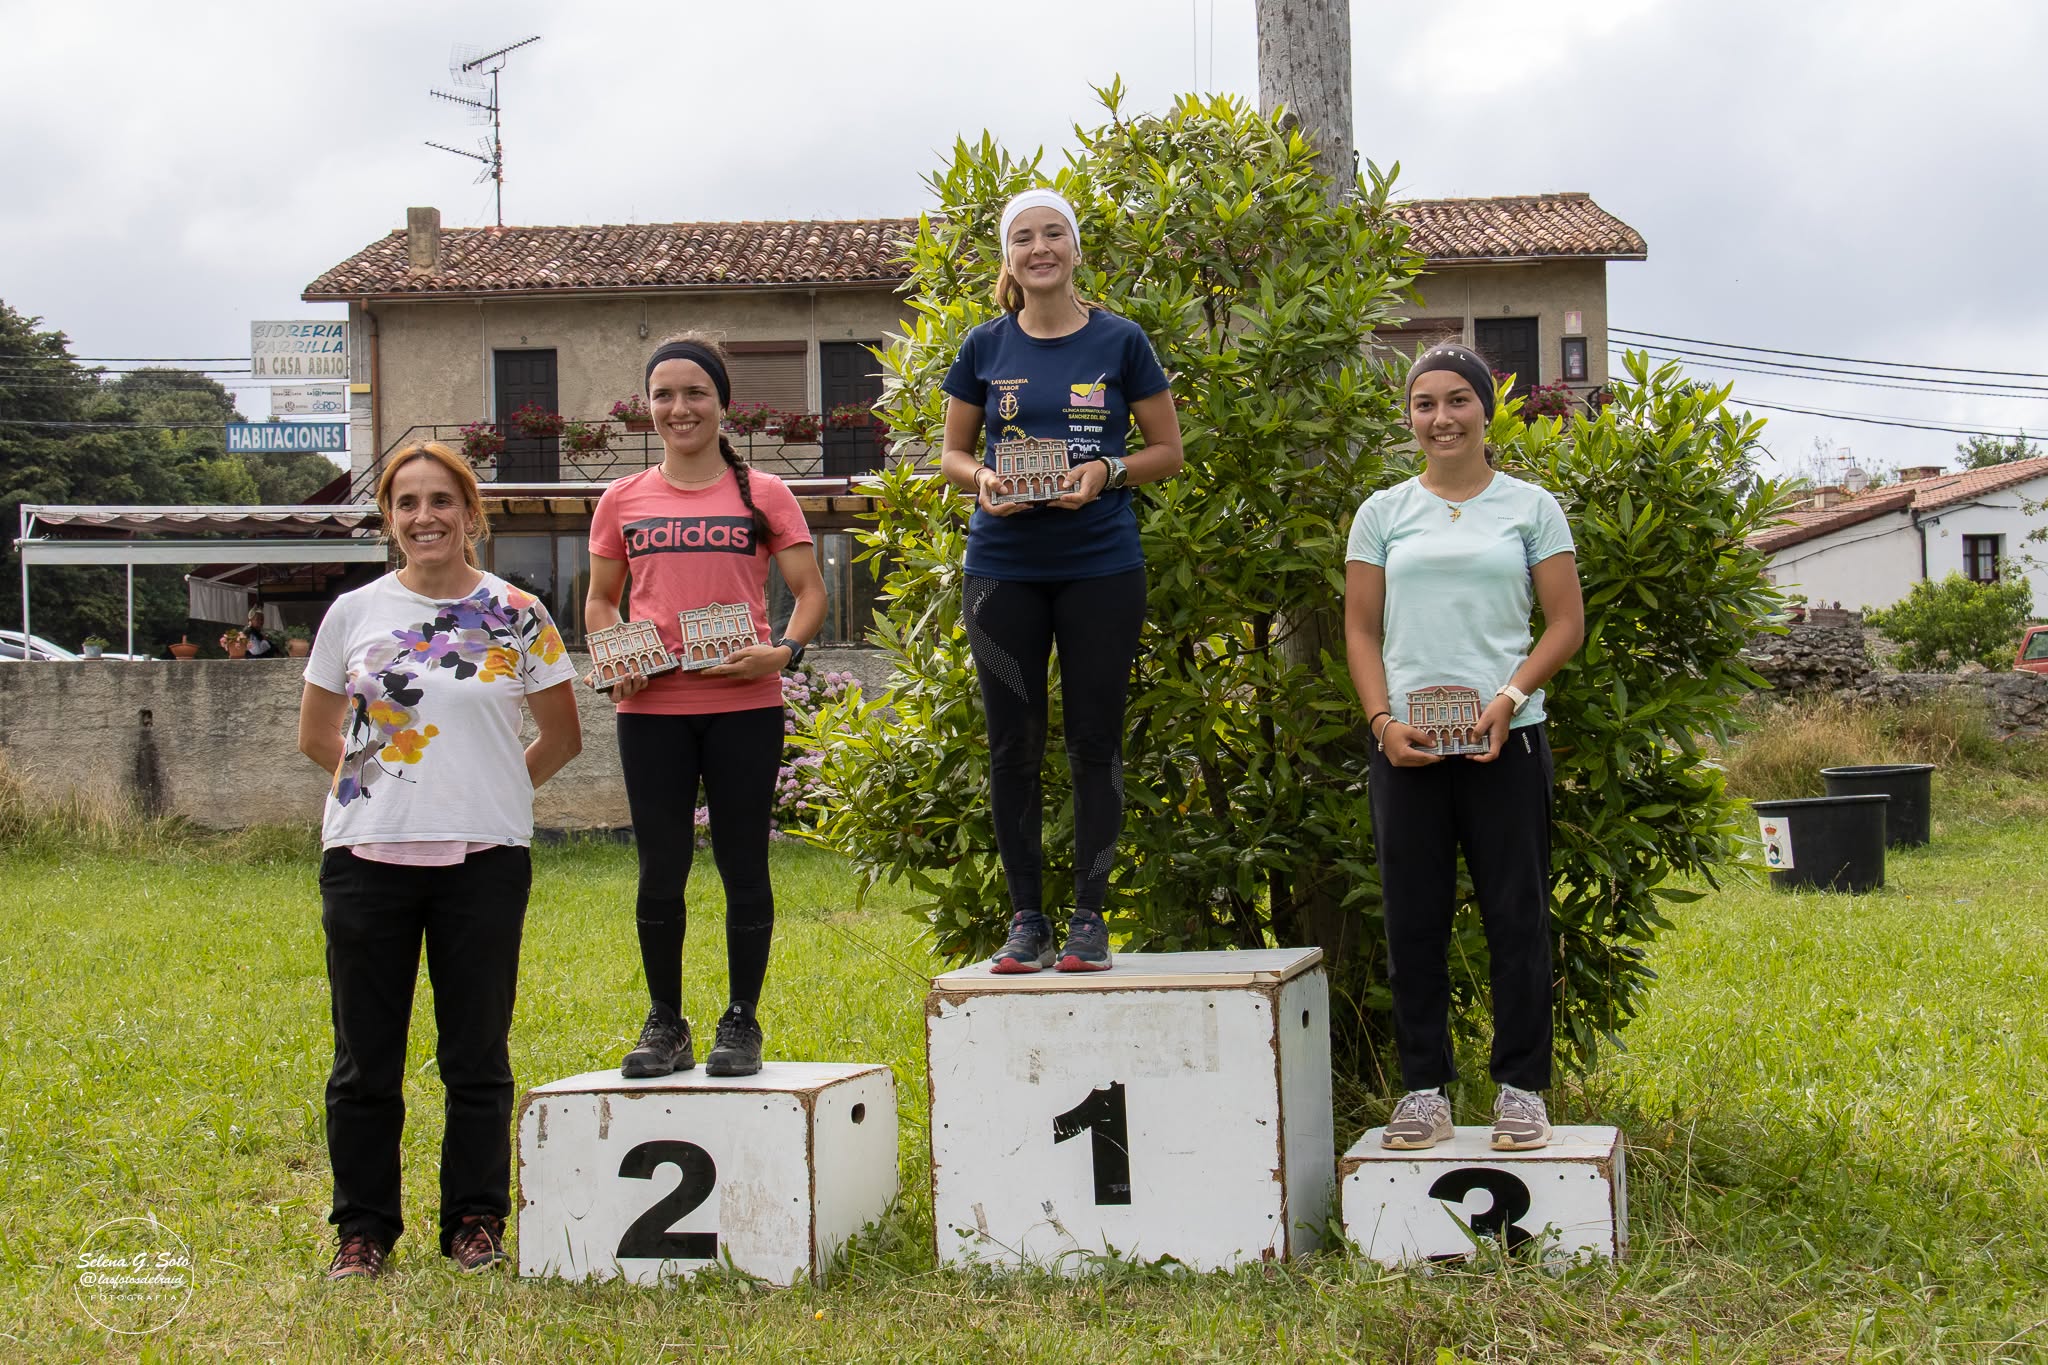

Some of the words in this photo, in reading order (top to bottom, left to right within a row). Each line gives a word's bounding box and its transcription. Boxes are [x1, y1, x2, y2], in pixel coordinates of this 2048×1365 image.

[272, 357, 301, 375] CASA
[308, 357, 343, 375] ABAJO
[230, 426, 340, 449] HABITACIONES
[632, 520, 749, 552] adidas
[1053, 1080, 1132, 1206] 1
[616, 1140, 718, 1260] 2
[1427, 1167, 1536, 1262] 3
